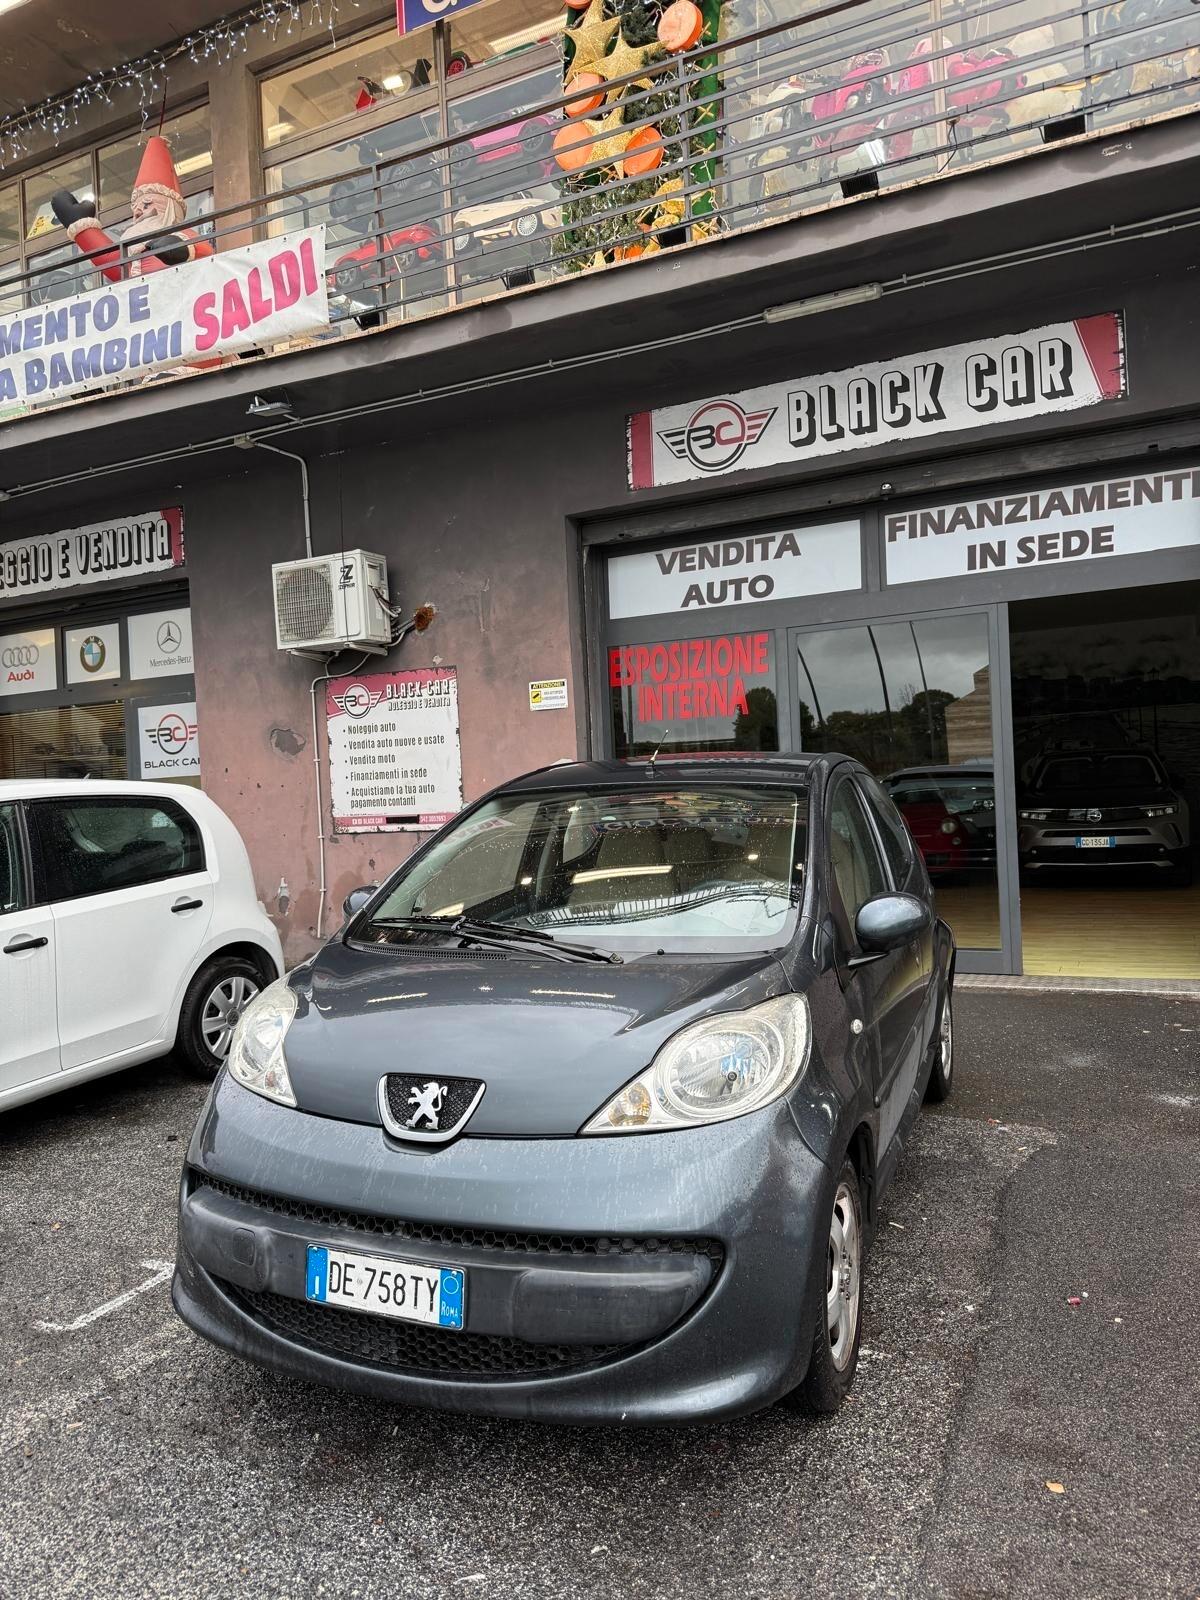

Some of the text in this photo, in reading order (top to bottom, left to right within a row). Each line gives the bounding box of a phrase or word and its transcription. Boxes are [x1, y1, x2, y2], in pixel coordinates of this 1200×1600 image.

[193, 238, 318, 352] SALDI
[0, 284, 151, 358] MENTO E
[24, 321, 183, 396] BAMBINI
[787, 337, 1074, 448] BLACK CAR
[888, 470, 1200, 543] FINANZIAMENTI
[0, 519, 172, 589] GGIO E VENDITA
[655, 533, 802, 575] VENDITA
[967, 525, 1114, 571] IN SEDE
[680, 574, 774, 608] AUTO
[8, 670, 35, 682] Audi
[150, 655, 192, 668] Mercedes-Benz
[608, 633, 769, 687] ESPOSIZIONE
[386, 679, 450, 700] BLACK CAR
[638, 679, 749, 722] INTERNA
[347, 722, 396, 735] Noleggio auto
[348, 735, 445, 750] Vendita auto nuove e usate
[144, 758, 179, 769] BLACK
[349, 754, 396, 765] Vendita moto
[350, 768, 428, 781] Finanziamenti in sede
[350, 796, 416, 809] pagamento contanti
[351, 783, 436, 798] Acquistiamo la tua auto
